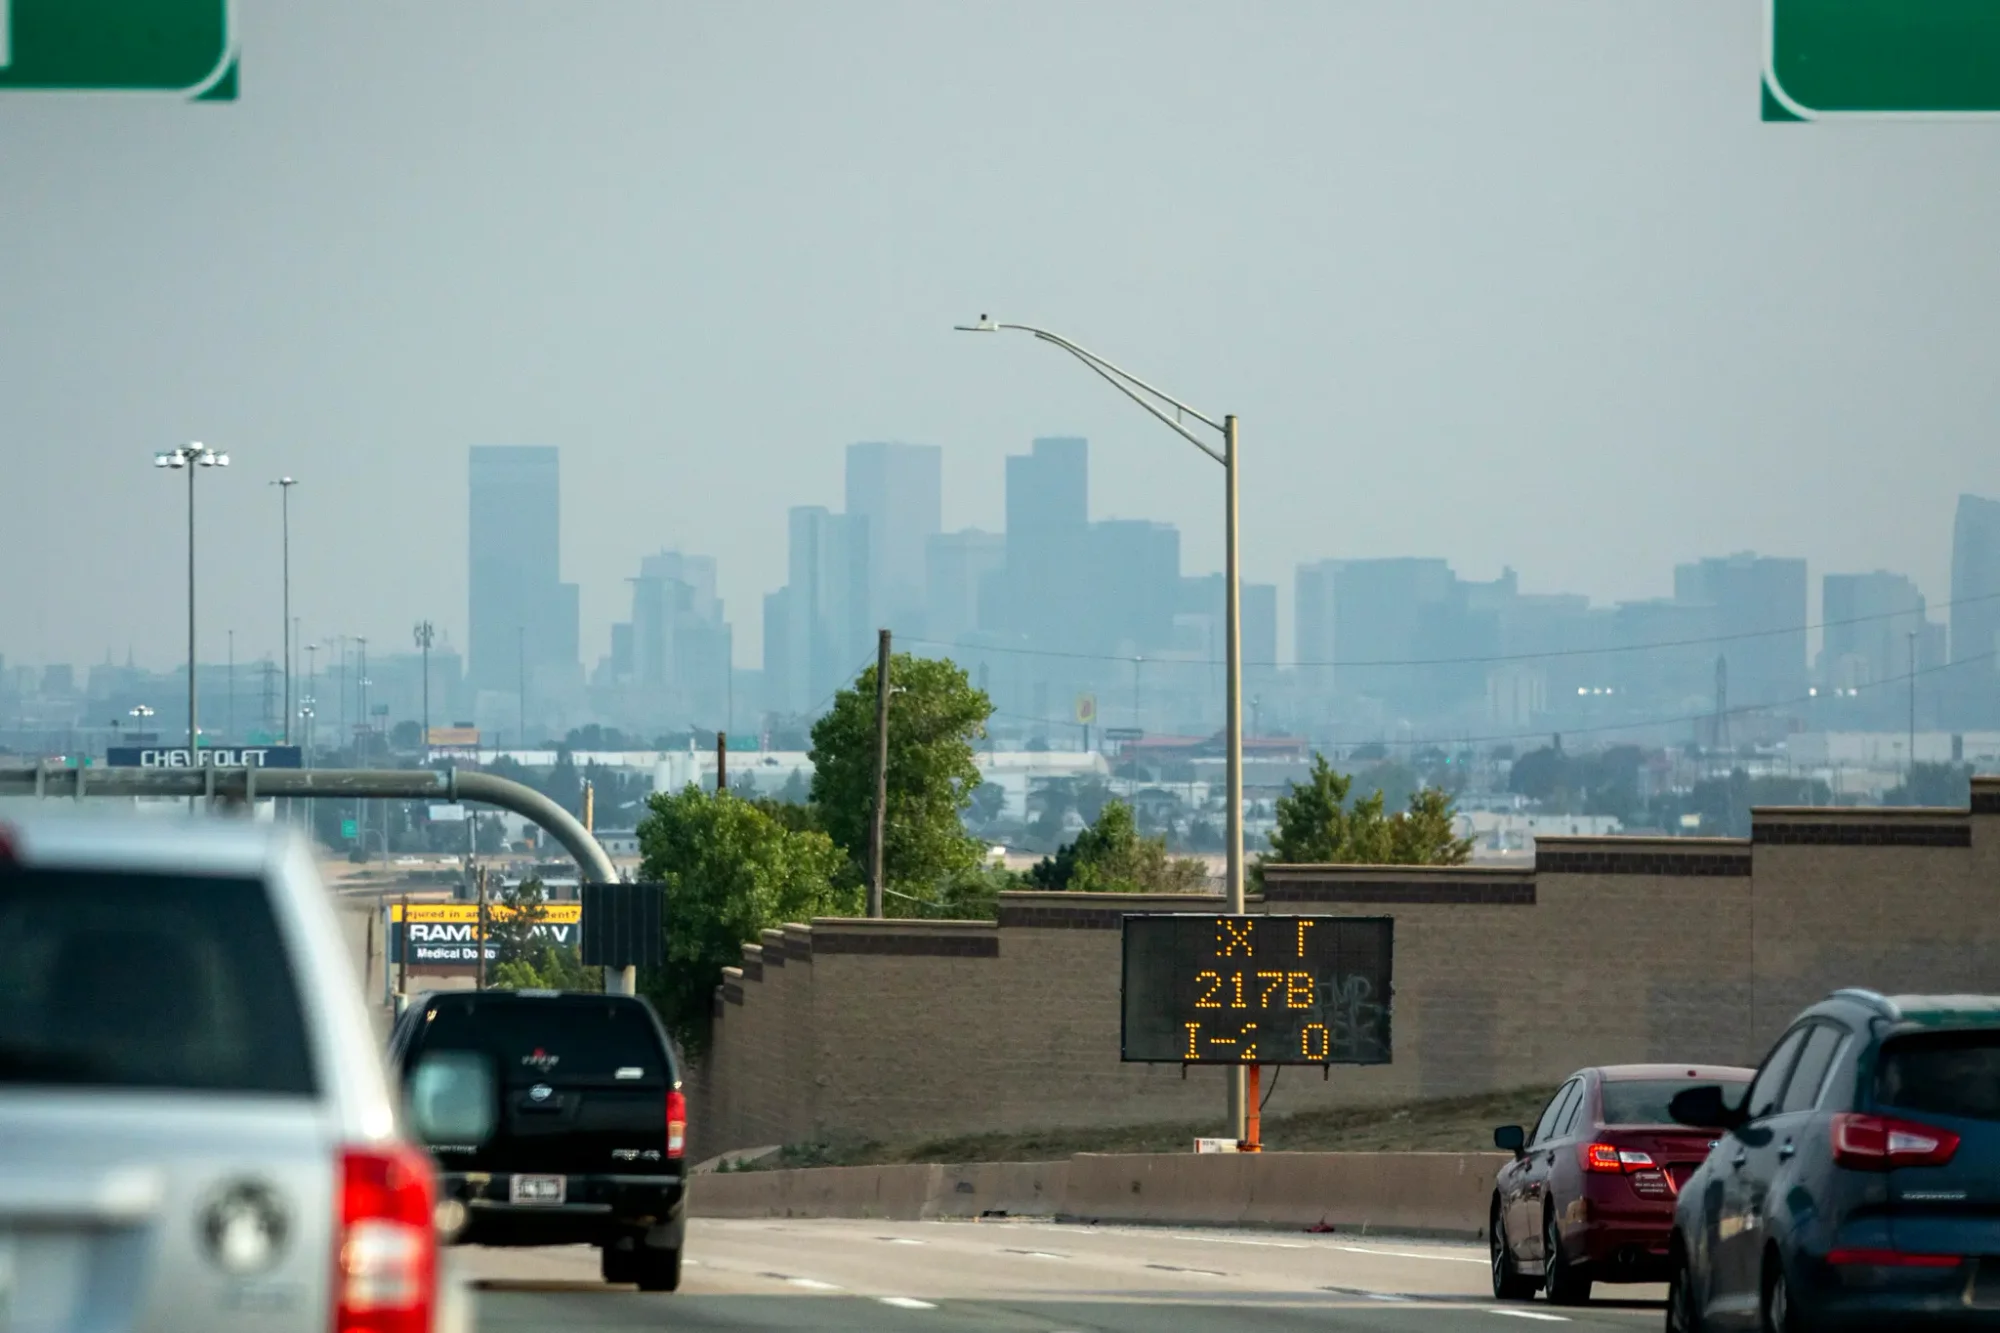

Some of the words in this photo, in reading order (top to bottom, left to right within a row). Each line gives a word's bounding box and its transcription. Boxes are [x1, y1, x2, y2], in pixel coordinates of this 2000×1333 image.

[405, 910, 445, 919] njured
[449, 910, 461, 918] in
[417, 948, 460, 958] Medical
[1195, 971, 1315, 1009] 217B
